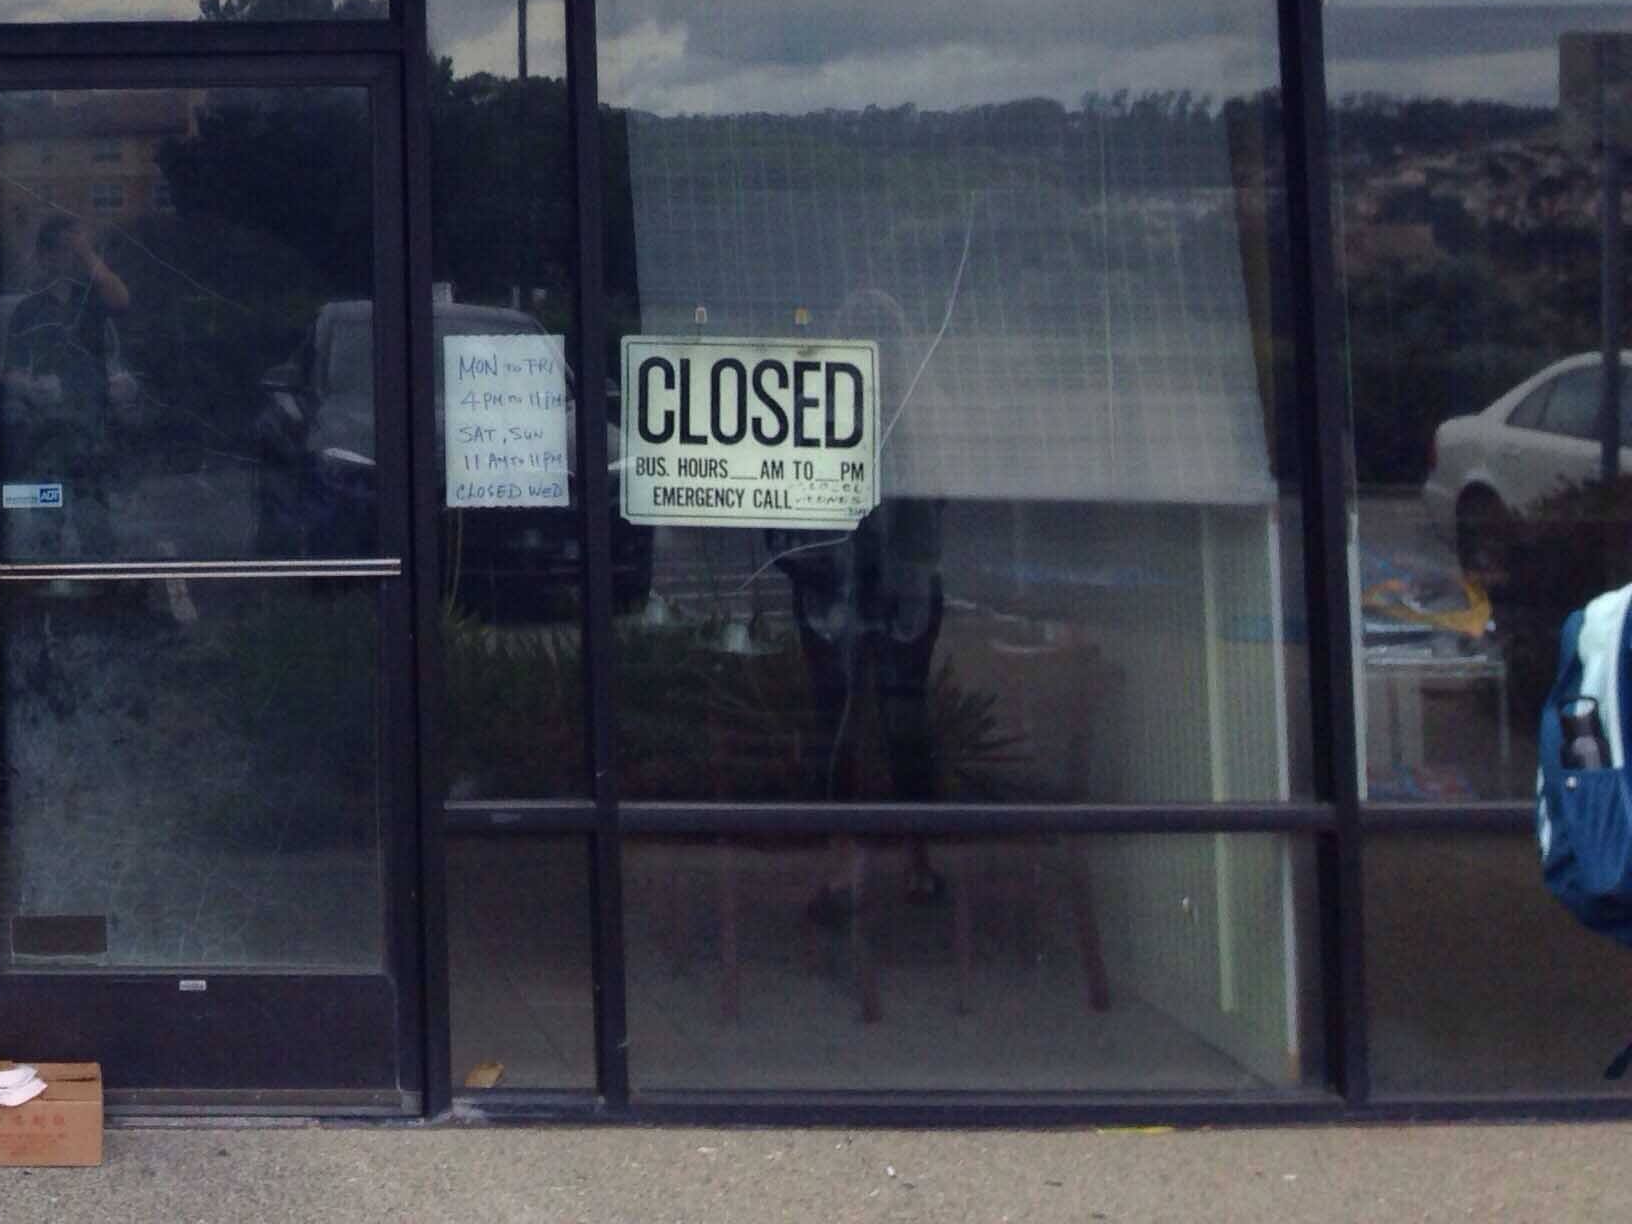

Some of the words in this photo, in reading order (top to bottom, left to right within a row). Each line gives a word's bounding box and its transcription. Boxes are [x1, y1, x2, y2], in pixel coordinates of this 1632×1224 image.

[459, 353, 498, 380] MON
[524, 359, 553, 376] FRI
[637, 356, 865, 449] CLOSED
[635, 456, 670, 477] BUS.
[678, 457, 728, 479] HOURS
[760, 460, 784, 480] AM
[793, 461, 814, 481] TO
[840, 462, 864, 481] PM
[456, 482, 522, 501] CLOSED
[528, 482, 563, 498] WED
[653, 486, 745, 508] EMERGENCY
[753, 488, 792, 510] CALL
